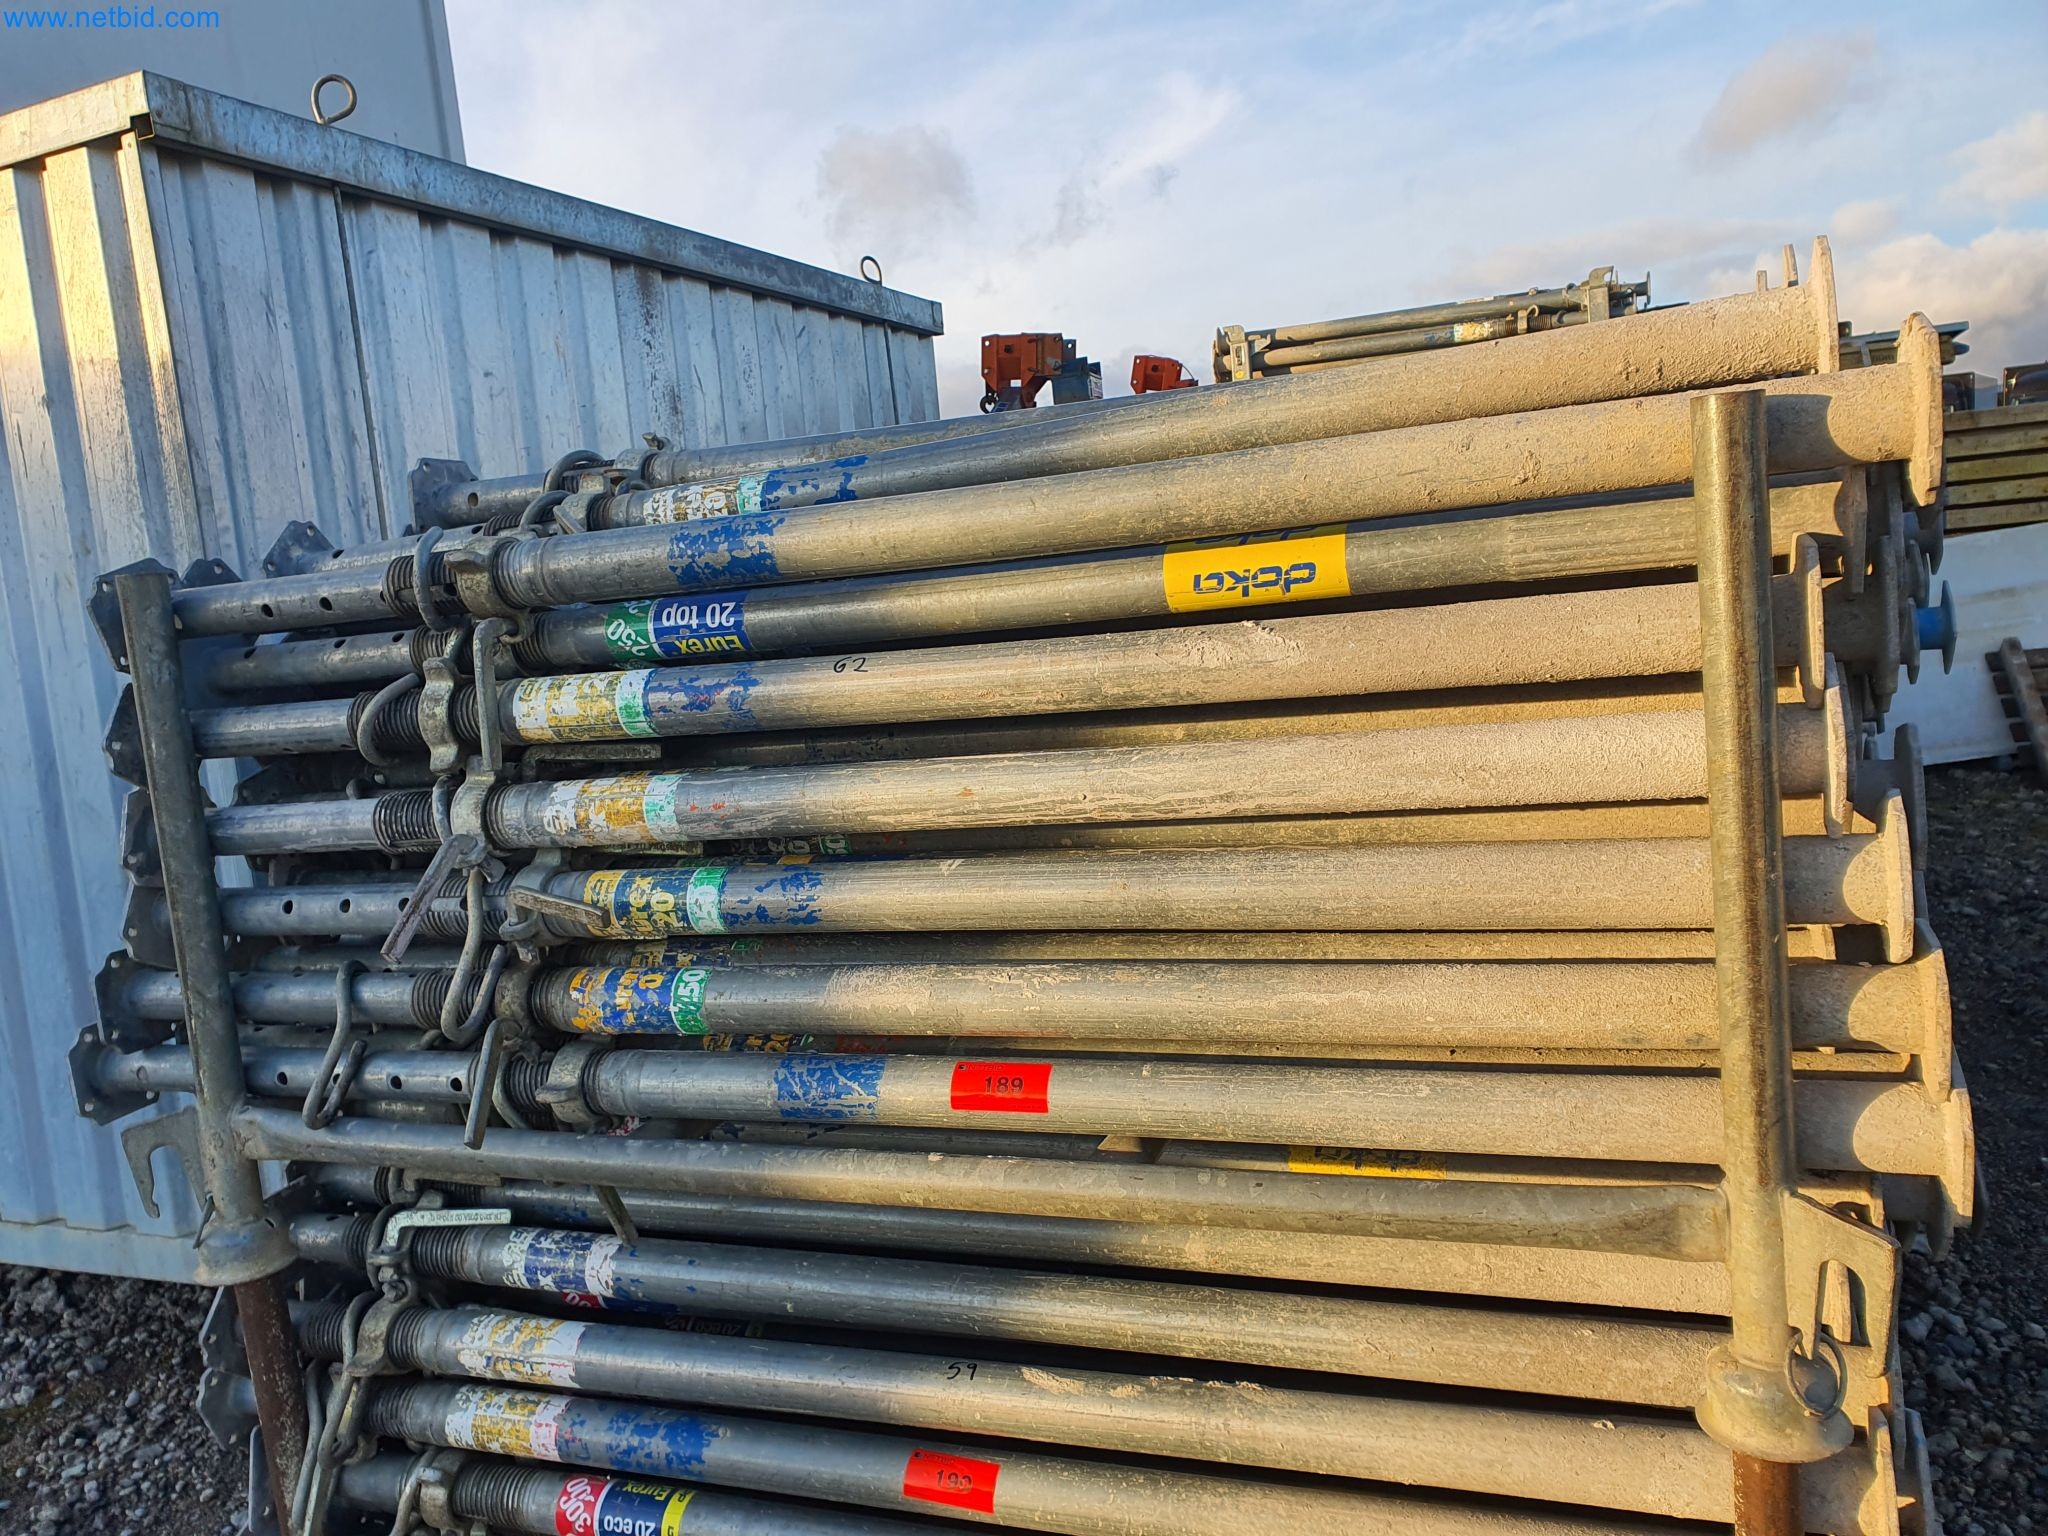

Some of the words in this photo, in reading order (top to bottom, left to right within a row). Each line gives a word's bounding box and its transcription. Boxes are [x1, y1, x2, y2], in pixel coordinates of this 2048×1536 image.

[662, 603, 699, 628] top
[705, 602, 736, 628] 20
[607, 619, 650, 656] 250
[674, 635, 745, 655] Eurex
[985, 1076, 1024, 1095] 189
[947, 1361, 978, 1380] 59
[624, 1480, 673, 1501] Eurex
[937, 1470, 972, 1493] 190
[604, 1515, 633, 1534] eco
